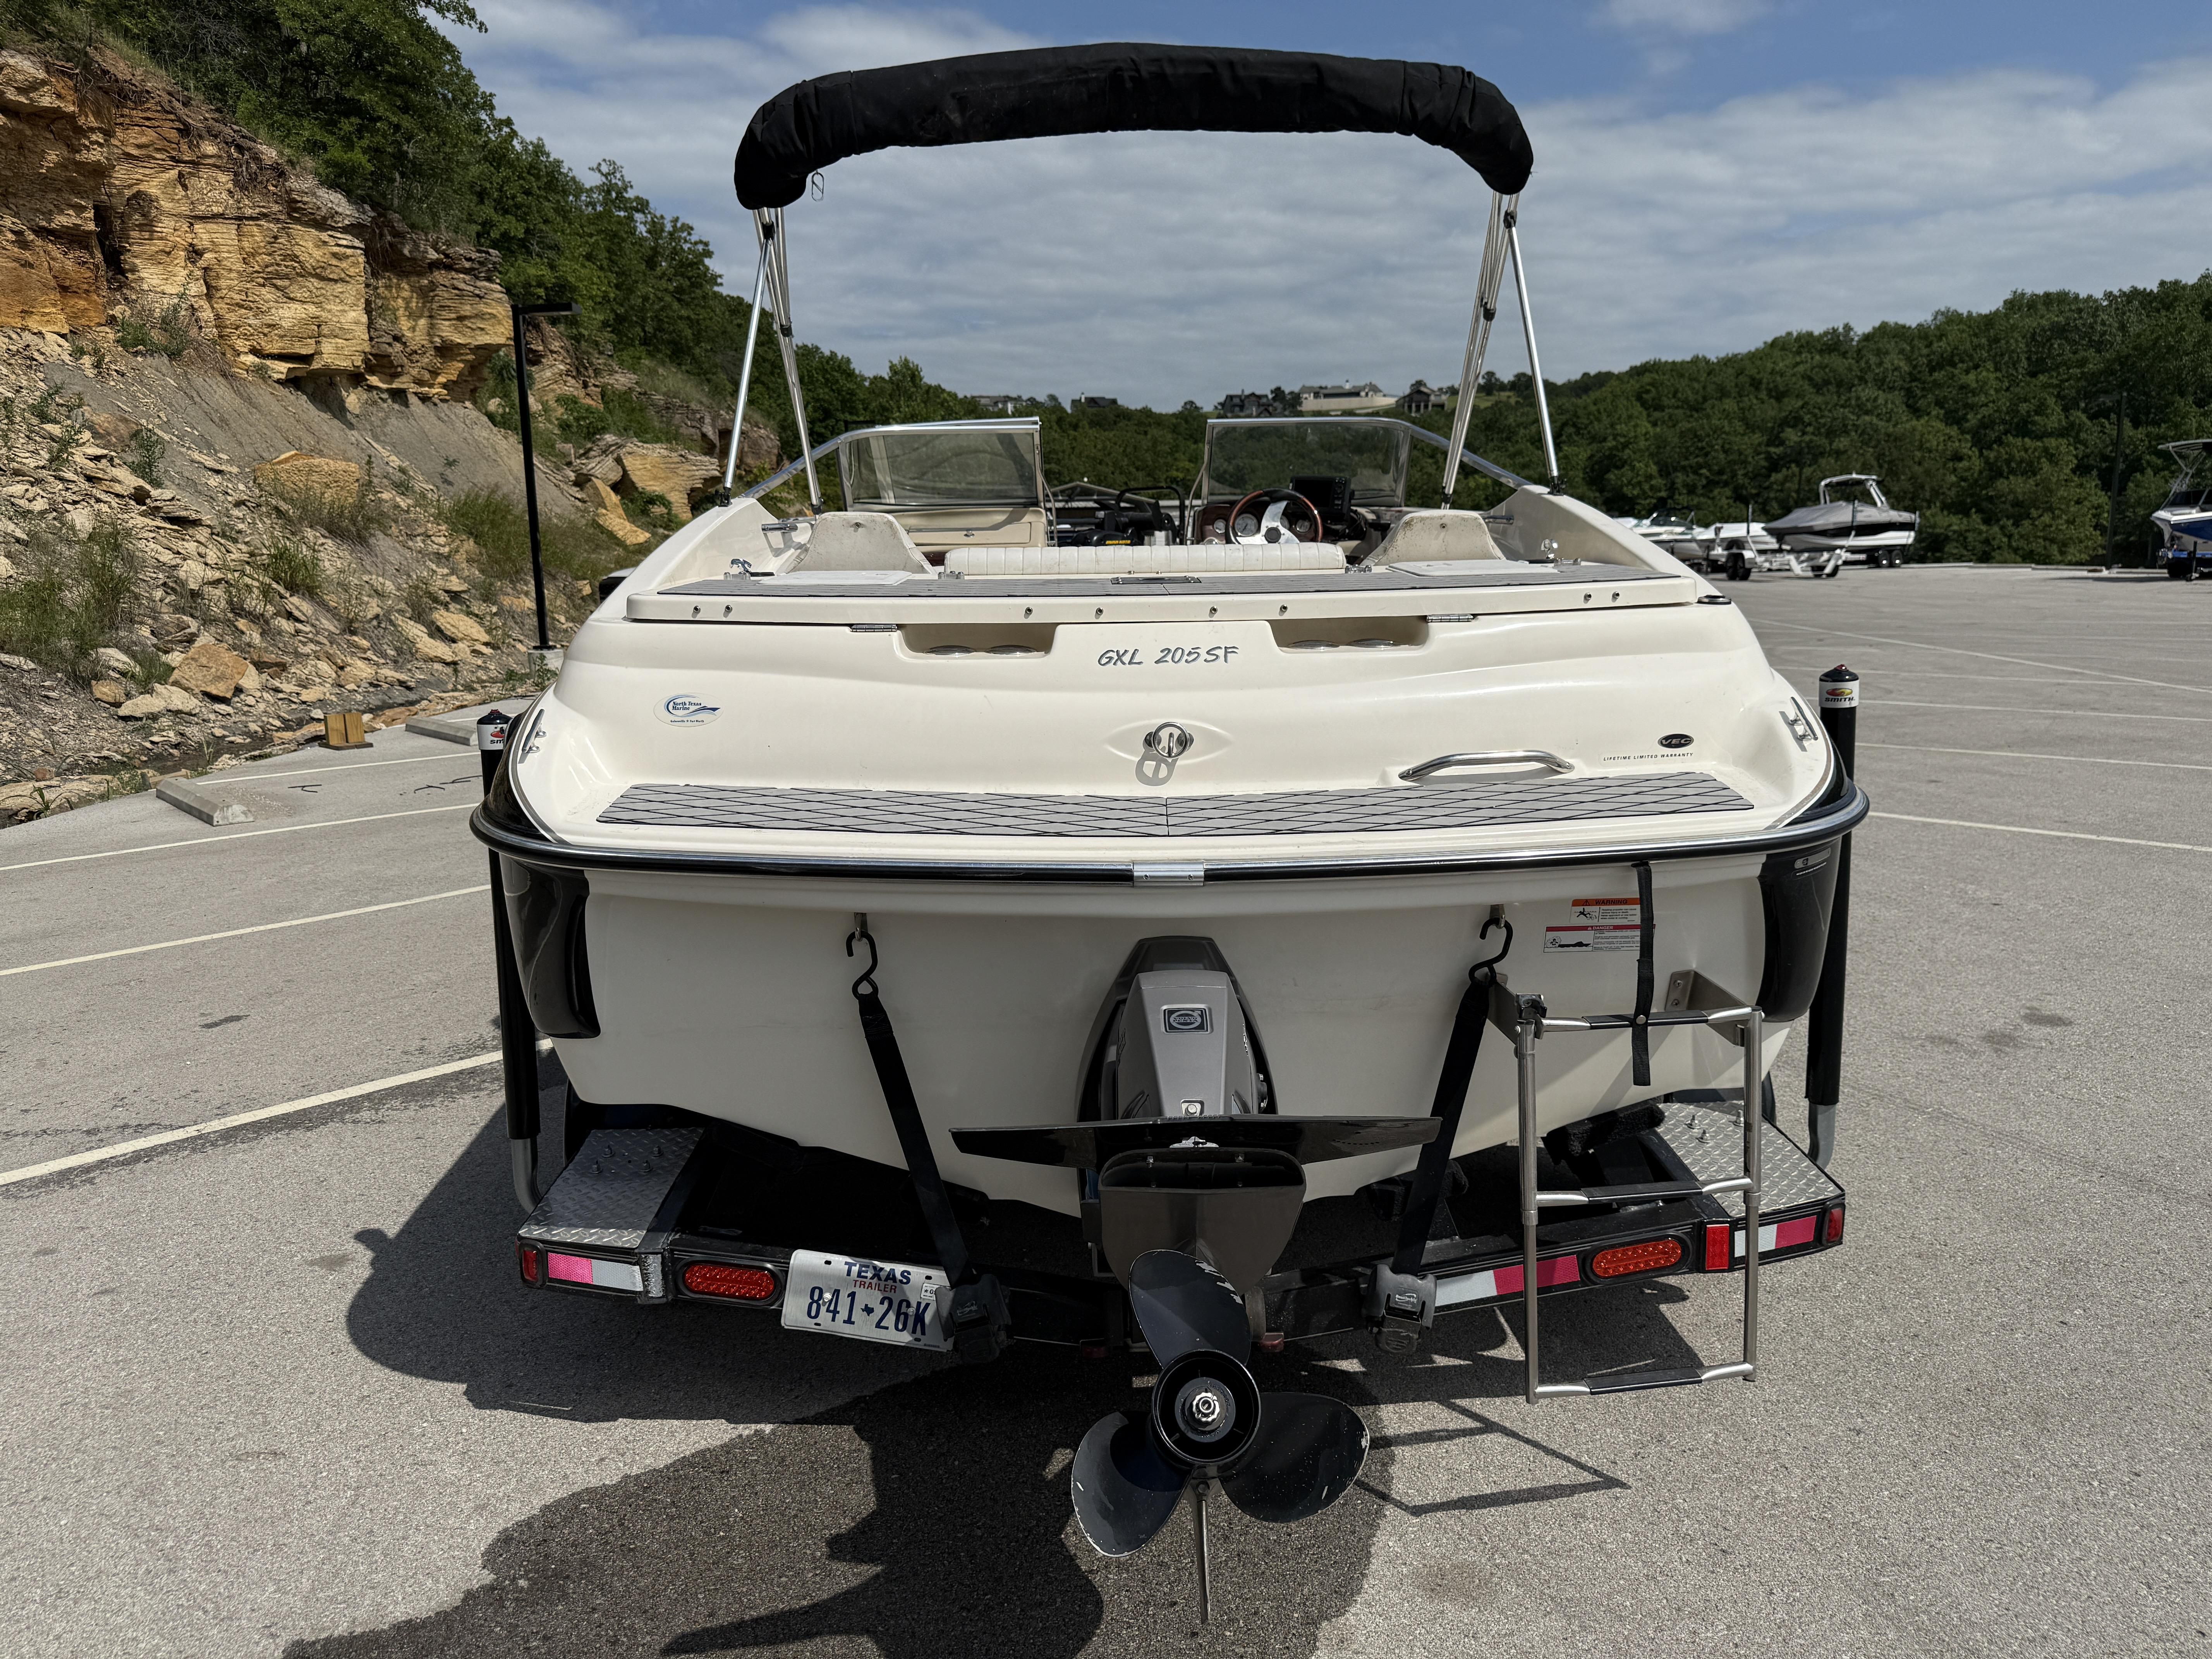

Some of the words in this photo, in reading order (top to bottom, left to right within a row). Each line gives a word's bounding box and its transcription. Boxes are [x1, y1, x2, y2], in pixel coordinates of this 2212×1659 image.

[1097, 649, 1144, 666] GXL
[844, 1261, 912, 1285] TEXAS
[852, 1279, 897, 1294] TRAILER
[807, 1286, 857, 1325] 841
[875, 1296, 931, 1336] 26K
